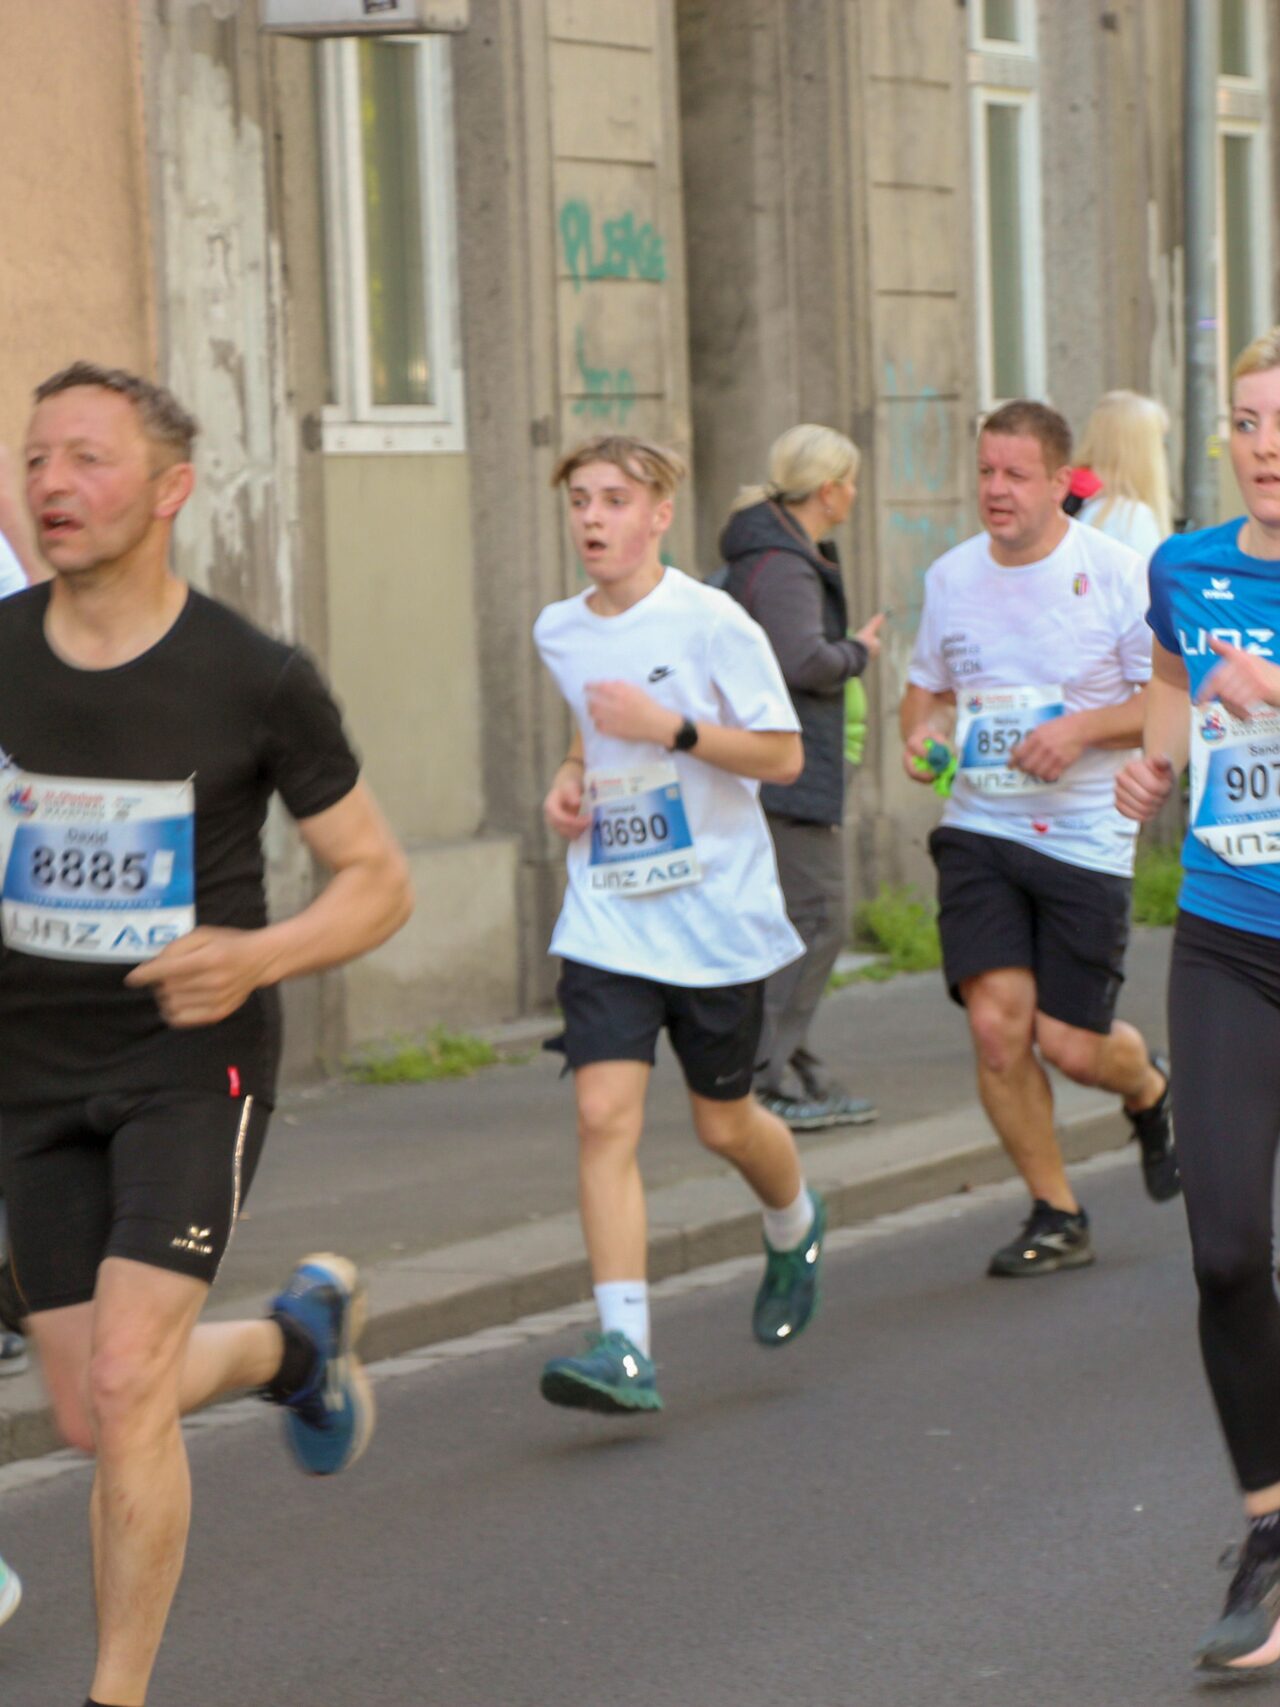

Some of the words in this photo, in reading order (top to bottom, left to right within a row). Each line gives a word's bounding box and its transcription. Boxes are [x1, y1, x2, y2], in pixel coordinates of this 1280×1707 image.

[977, 728, 1034, 756] 852
[31, 846, 149, 892] 8885
[592, 870, 638, 890] LINZ
[646, 860, 690, 884] AG
[11, 910, 101, 946] LINZ
[111, 924, 179, 950] AG
